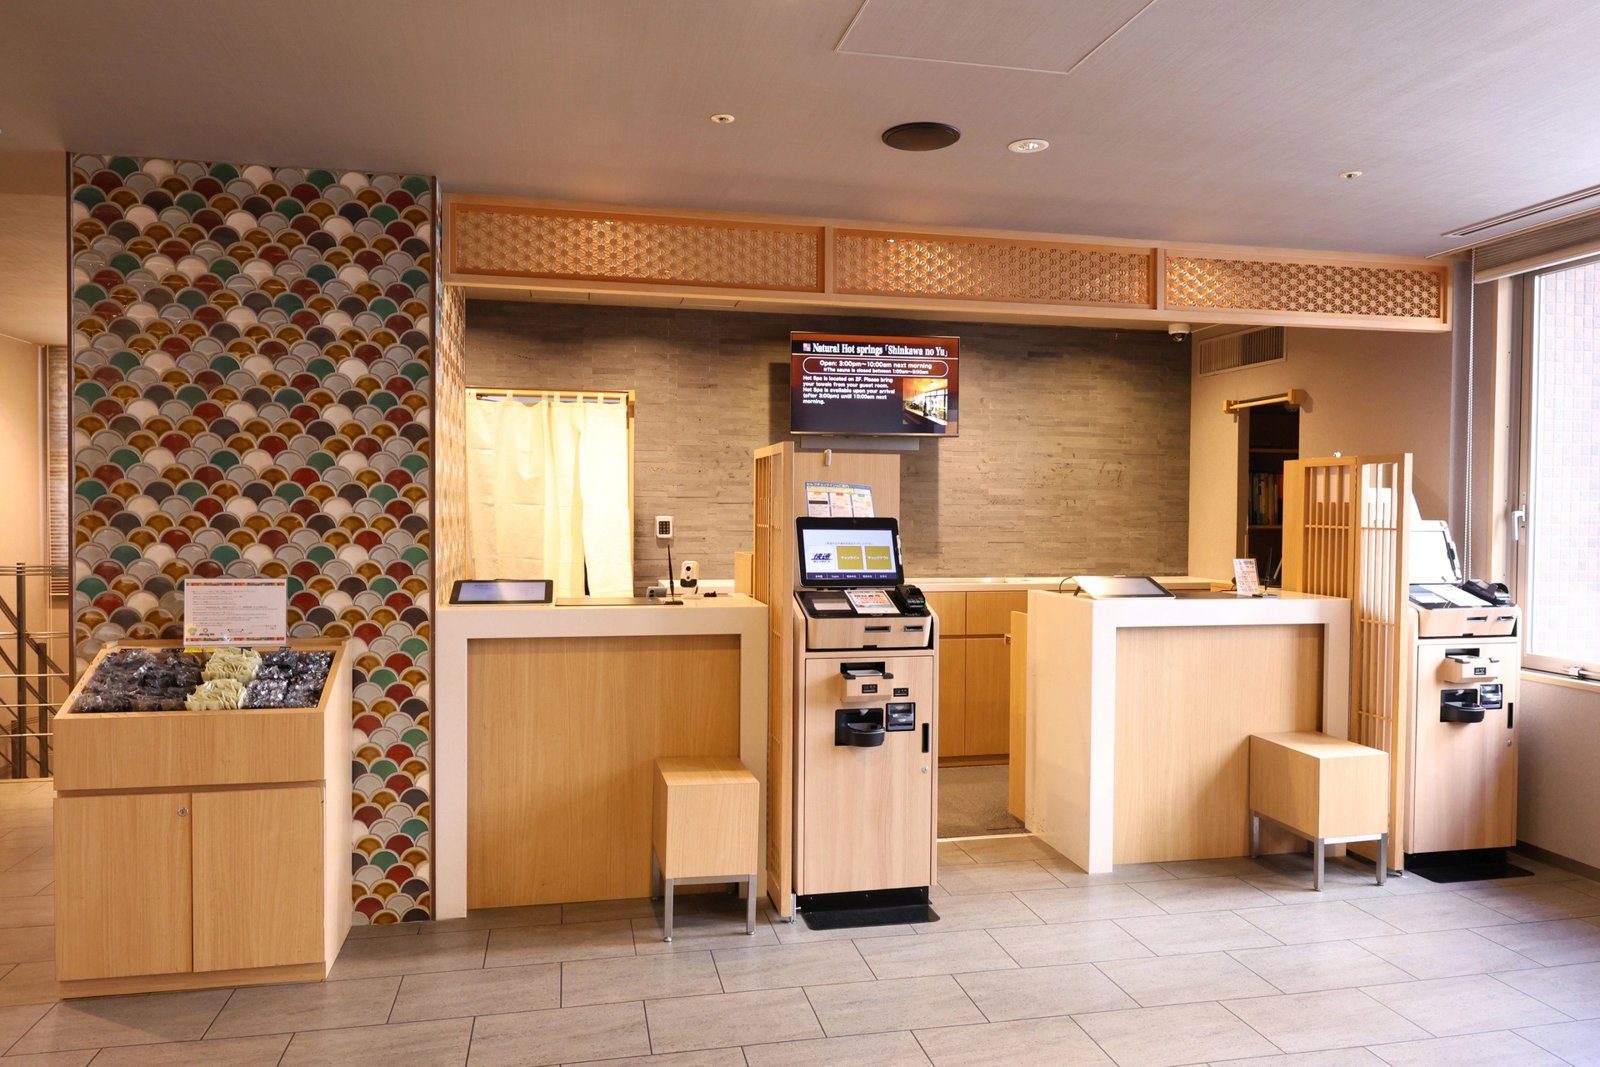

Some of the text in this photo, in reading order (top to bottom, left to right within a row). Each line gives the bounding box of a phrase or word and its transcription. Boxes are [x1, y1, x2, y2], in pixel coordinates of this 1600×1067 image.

[813, 344, 839, 353] Natural
[842, 344, 855, 353] Hot
[857, 345, 882, 356] springs
